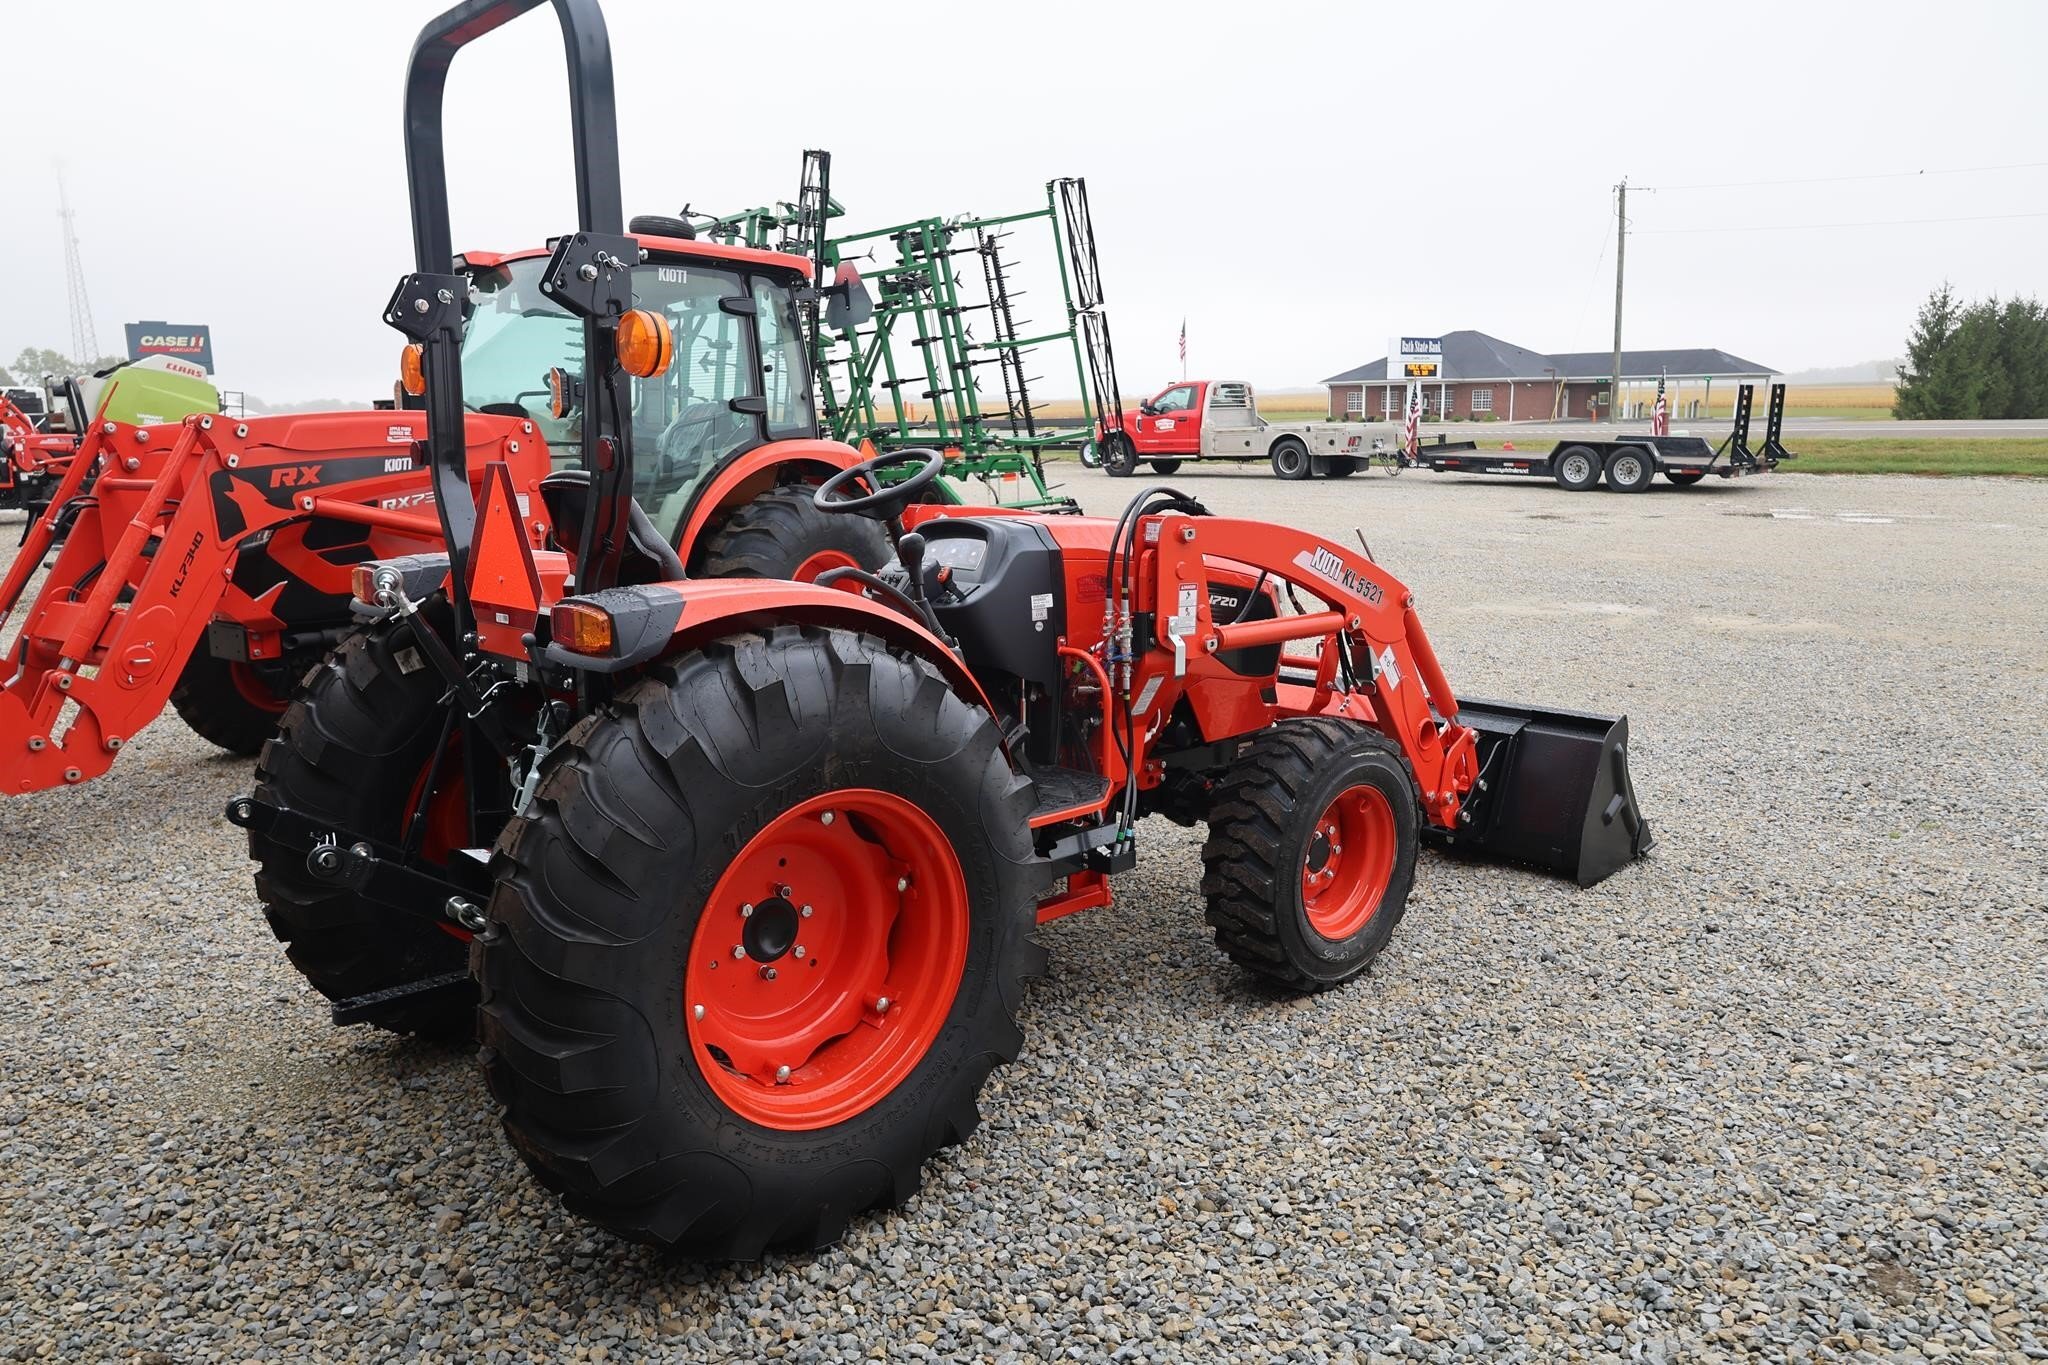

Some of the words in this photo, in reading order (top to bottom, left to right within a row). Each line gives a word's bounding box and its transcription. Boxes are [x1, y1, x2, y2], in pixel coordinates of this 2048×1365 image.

[658, 267, 687, 284] KIOTI
[140, 335, 188, 347] CASE
[1401, 340, 1414, 353] Bath
[1414, 340, 1428, 353] State
[1428, 340, 1442, 353] Bank
[165, 362, 203, 378] CLAAS
[384, 457, 412, 473] KIOTI
[269, 465, 322, 488] RX
[169, 531, 204, 598] KL7340
[1310, 545, 1344, 581] KIOTI
[1341, 567, 1384, 604] KL5521
